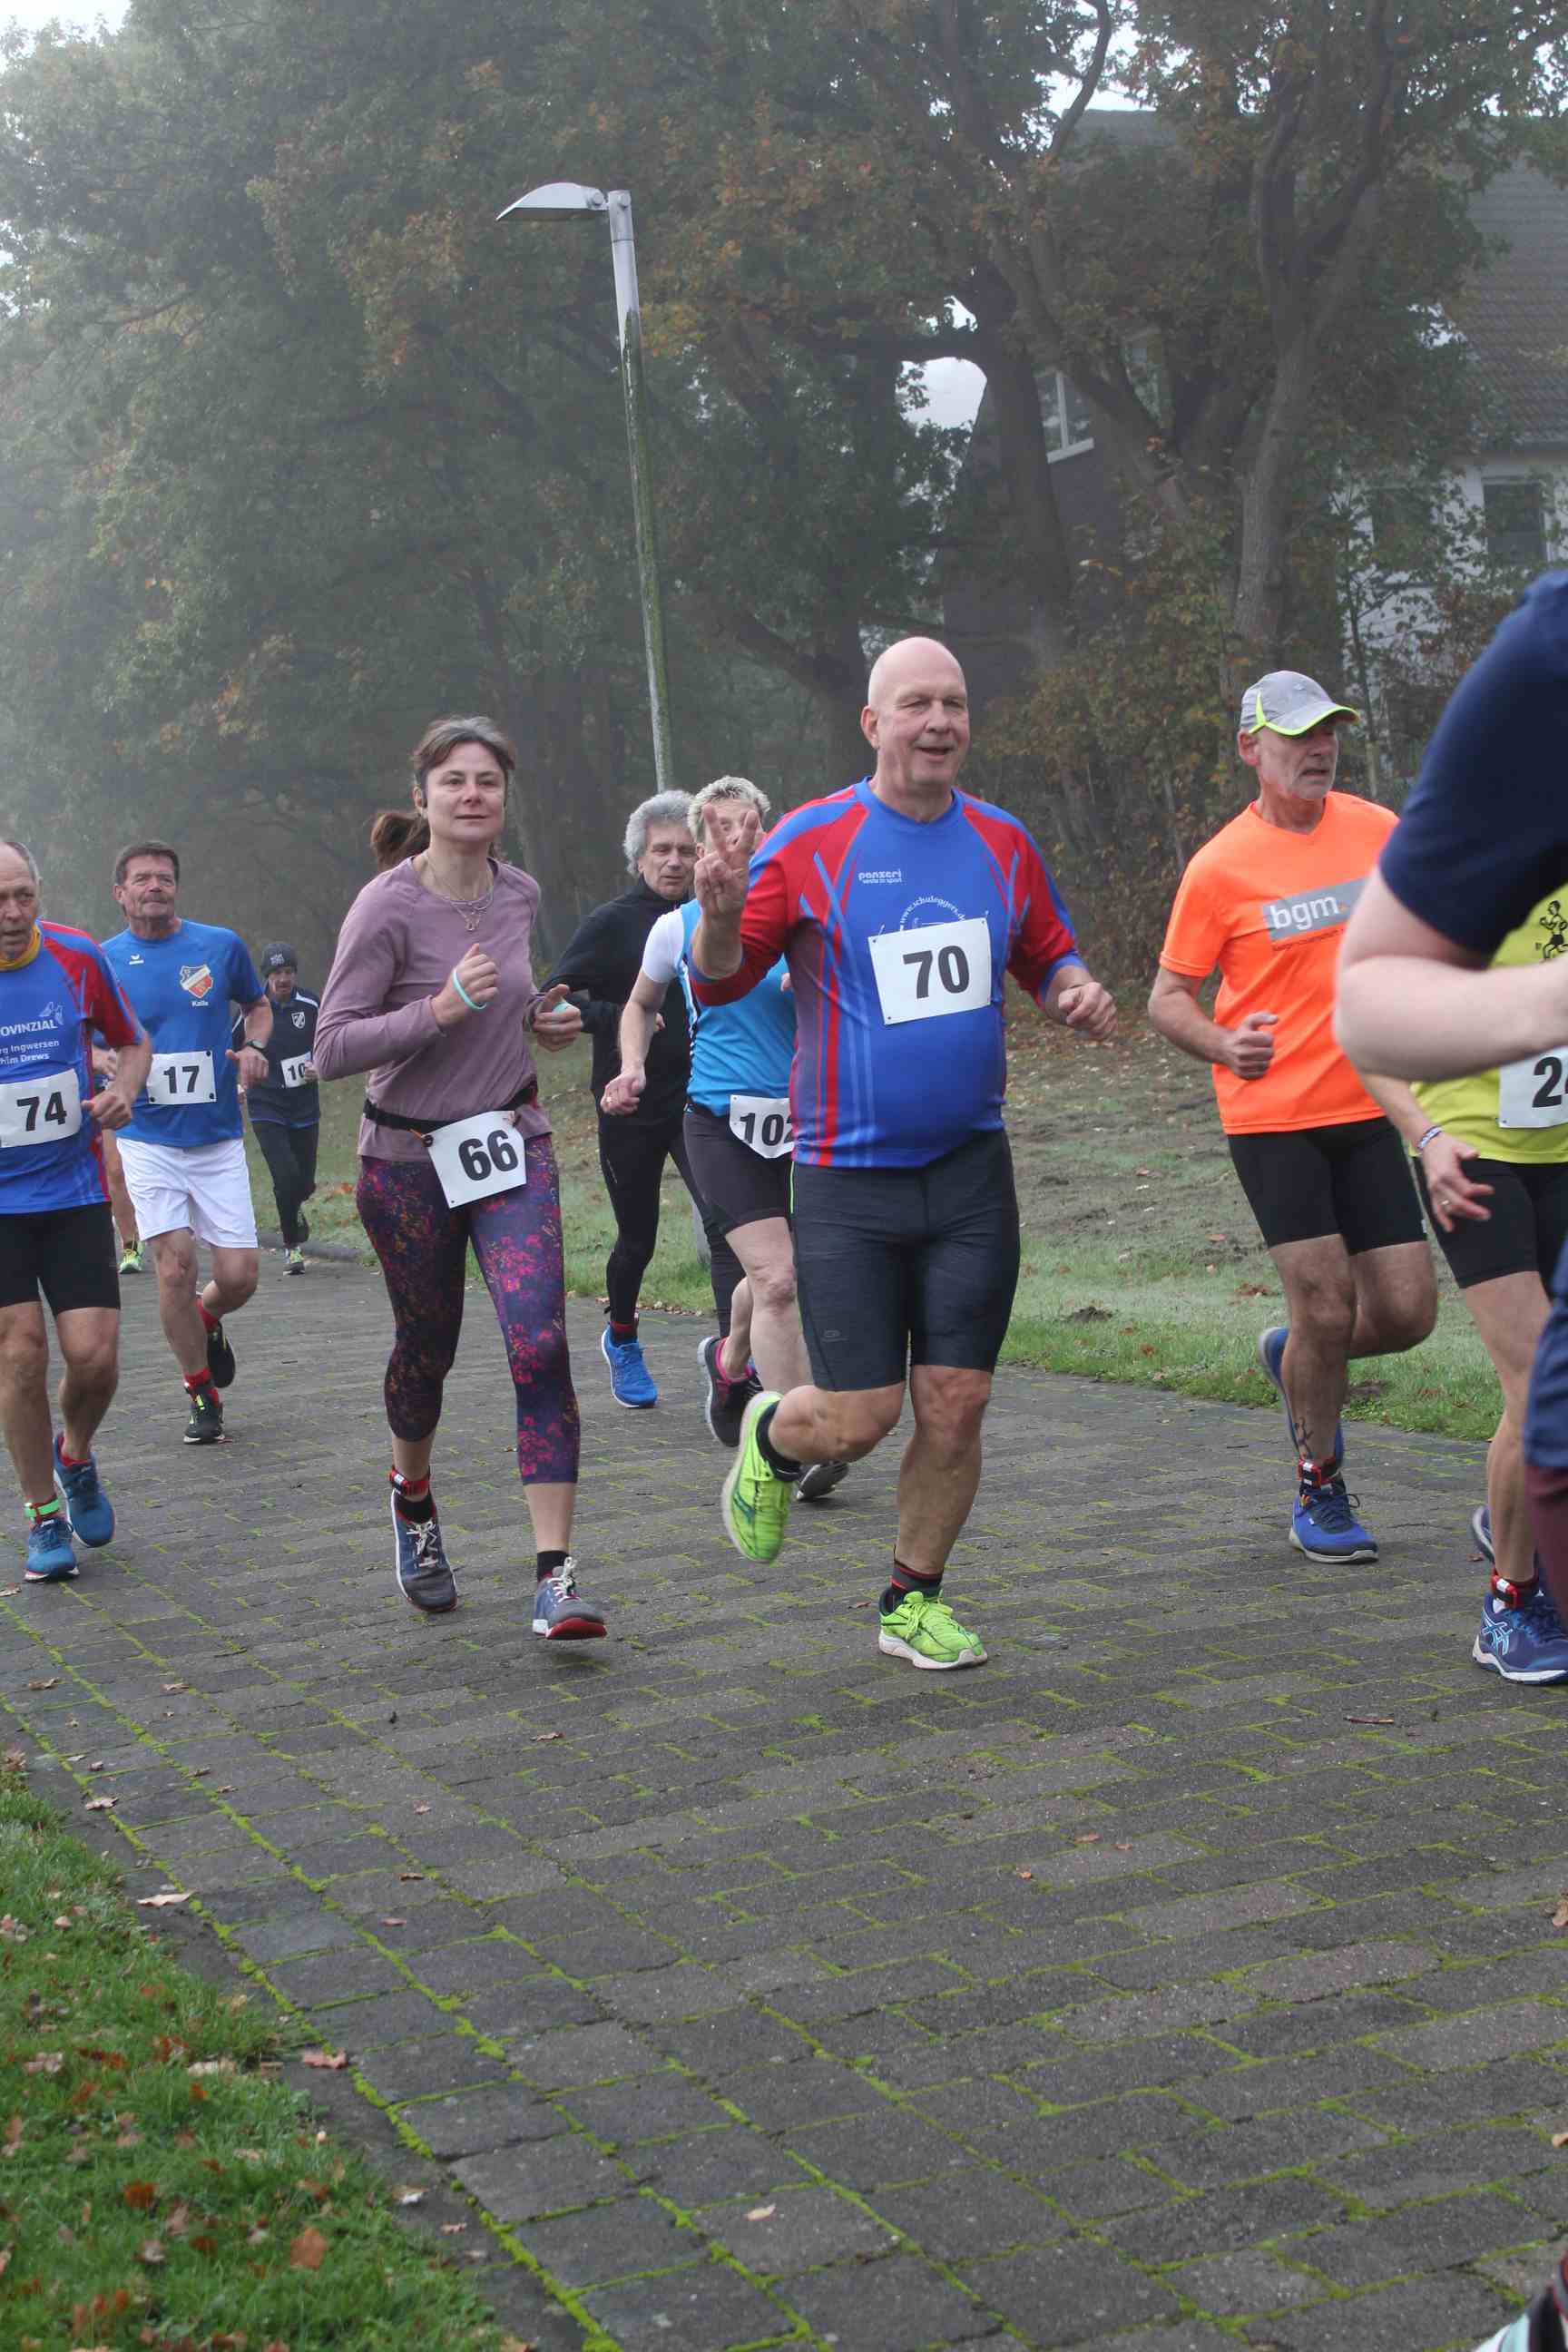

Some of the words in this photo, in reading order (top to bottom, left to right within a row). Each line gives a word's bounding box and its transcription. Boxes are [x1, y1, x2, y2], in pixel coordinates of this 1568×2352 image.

[902, 945, 970, 999] 70
[11, 1040, 59, 1053] Ingwersen
[20, 1053, 51, 1063] Drews
[163, 1065, 200, 1094] 17
[1531, 1056, 1568, 1108] 2
[16, 1092, 67, 1132] 74
[458, 1129, 519, 1181] 66
